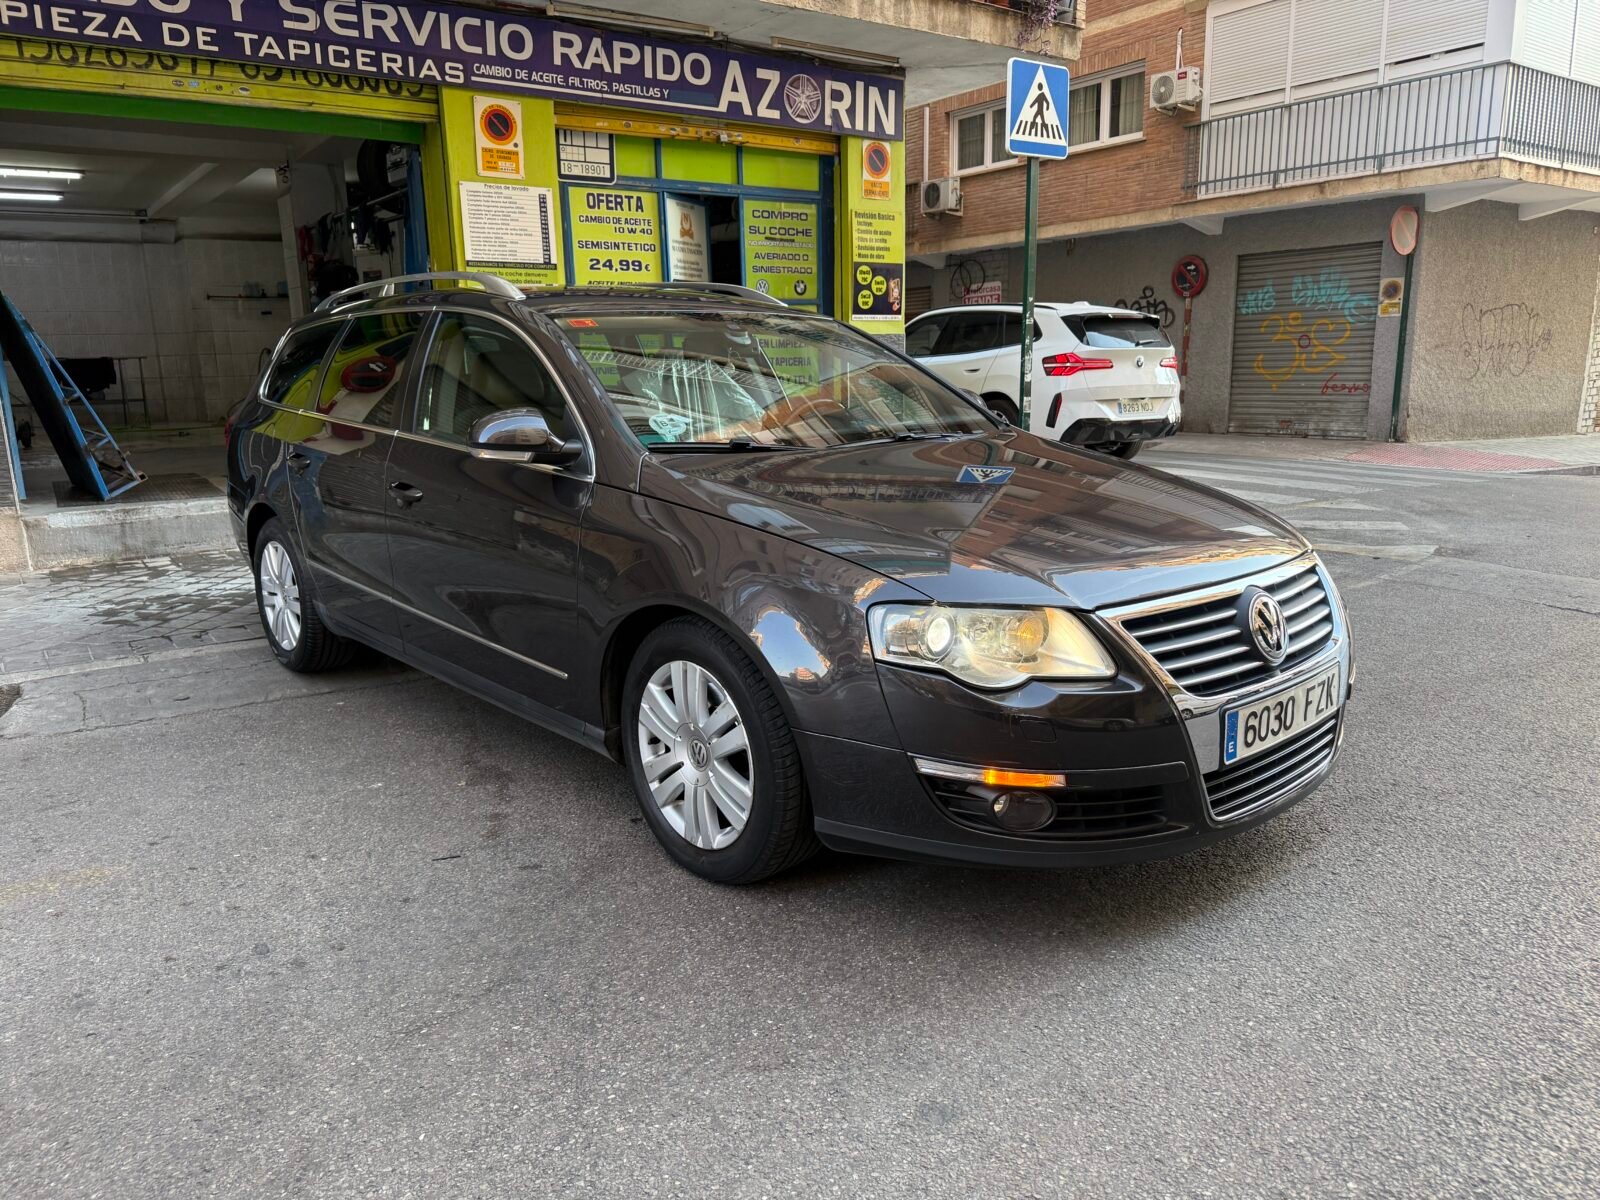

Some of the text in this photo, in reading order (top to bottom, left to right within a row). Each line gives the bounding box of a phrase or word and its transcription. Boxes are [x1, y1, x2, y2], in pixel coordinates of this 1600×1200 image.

[0, 2, 143, 42] PIEZA
[162, 22, 219, 51] DE
[234, 31, 464, 84] TAPICERIAS
[279, 0, 533, 61] SERVICIO
[553, 30, 712, 86] RAPIDO
[473, 63, 669, 98] CAMBIO DE ACEITE, FILTROS, PASTILLAS Y
[586, 192, 644, 212] OFERTA
[578, 215, 652, 226] CAMBIO DE ACEITE
[752, 210, 808, 221] COMPRO
[748, 225, 812, 237] SU COCHE
[577, 240, 656, 252] SEMISINTETICO
[754, 252, 801, 261] AVERIADO
[752, 265, 812, 275] SINIESTRADO
[1123, 402, 1140, 413] 8263
[1228, 672, 1336, 753] E 6030 FZK
